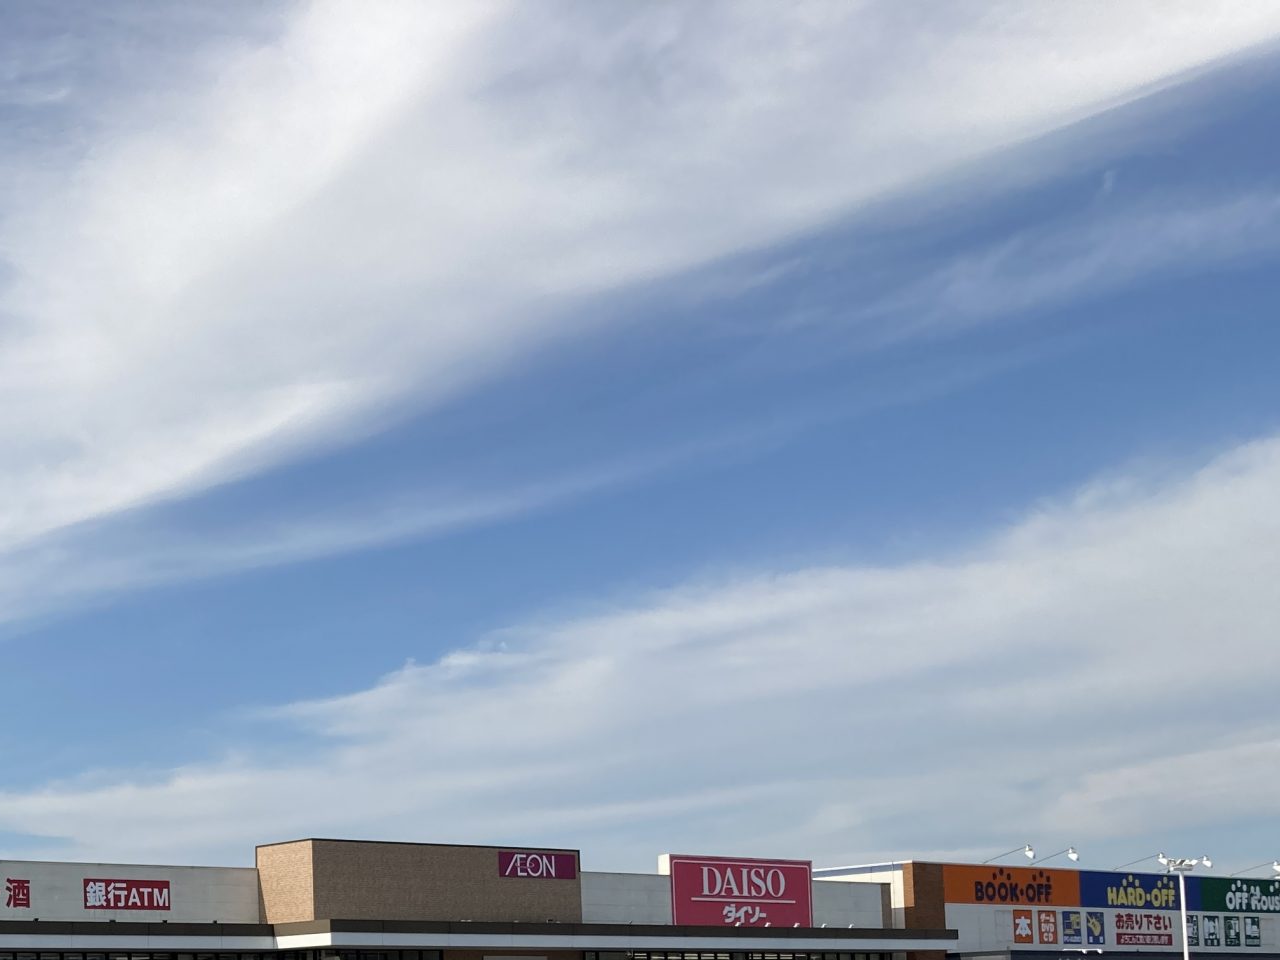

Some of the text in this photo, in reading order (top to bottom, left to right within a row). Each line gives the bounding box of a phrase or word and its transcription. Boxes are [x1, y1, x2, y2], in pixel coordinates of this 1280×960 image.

[701, 866, 786, 898] DAISO
[86, 882, 169, 907] 銀行ATM
[1226, 891, 1248, 910] OFF
[722, 904, 767, 924] ダイソー
[1041, 923, 1055, 932] DVD
[1043, 932, 1054, 942] CD
